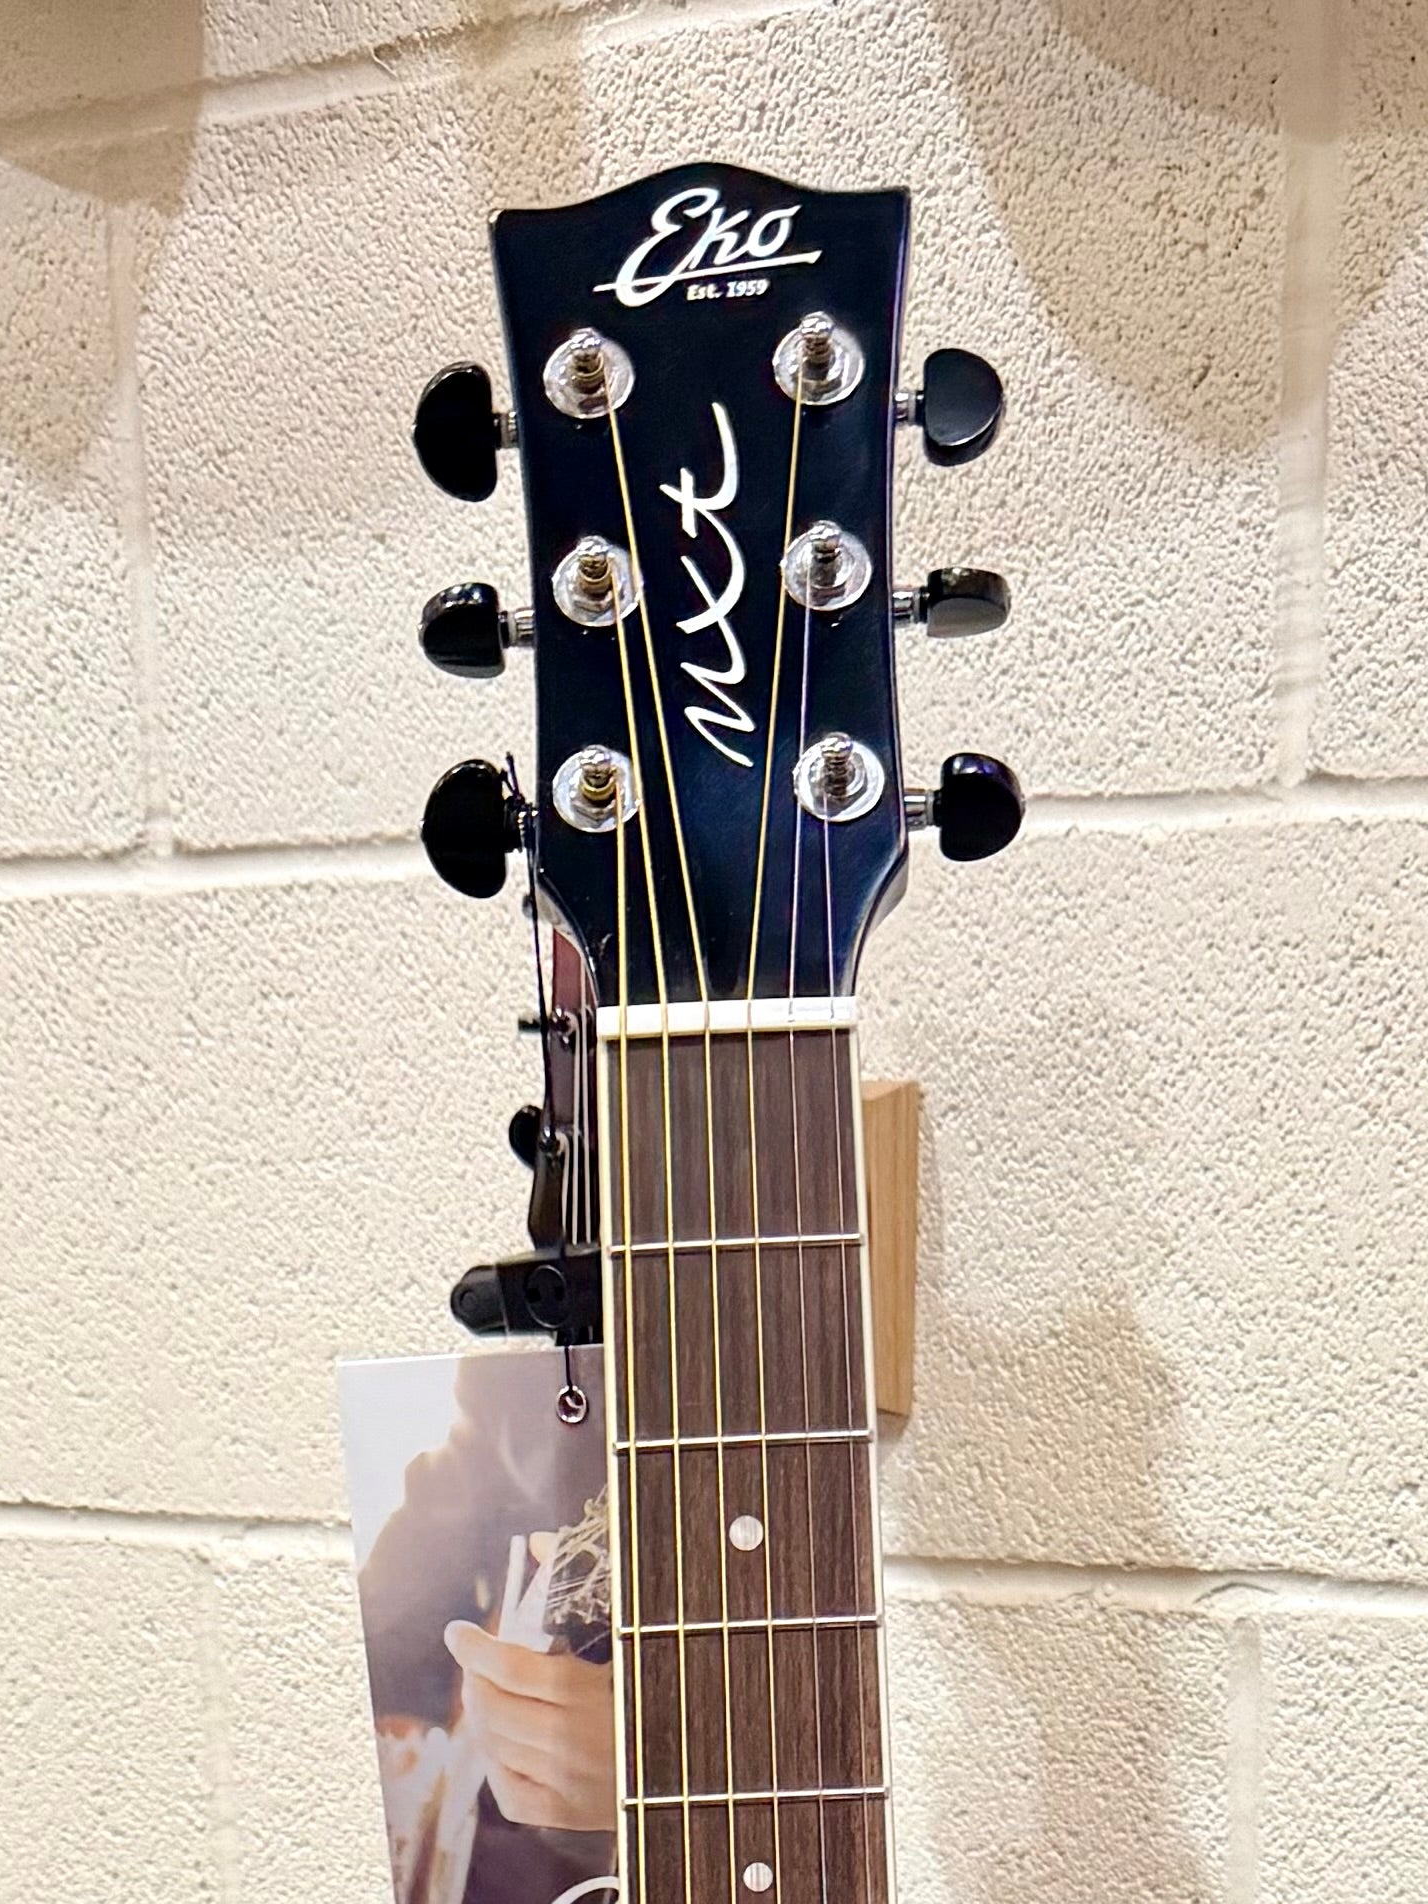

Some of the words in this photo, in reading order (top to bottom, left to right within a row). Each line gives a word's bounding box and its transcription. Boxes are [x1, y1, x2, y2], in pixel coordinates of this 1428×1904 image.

[615, 187, 804, 307] Eko
[686, 283, 724, 301] Est.
[726, 279, 772, 298] 1959
